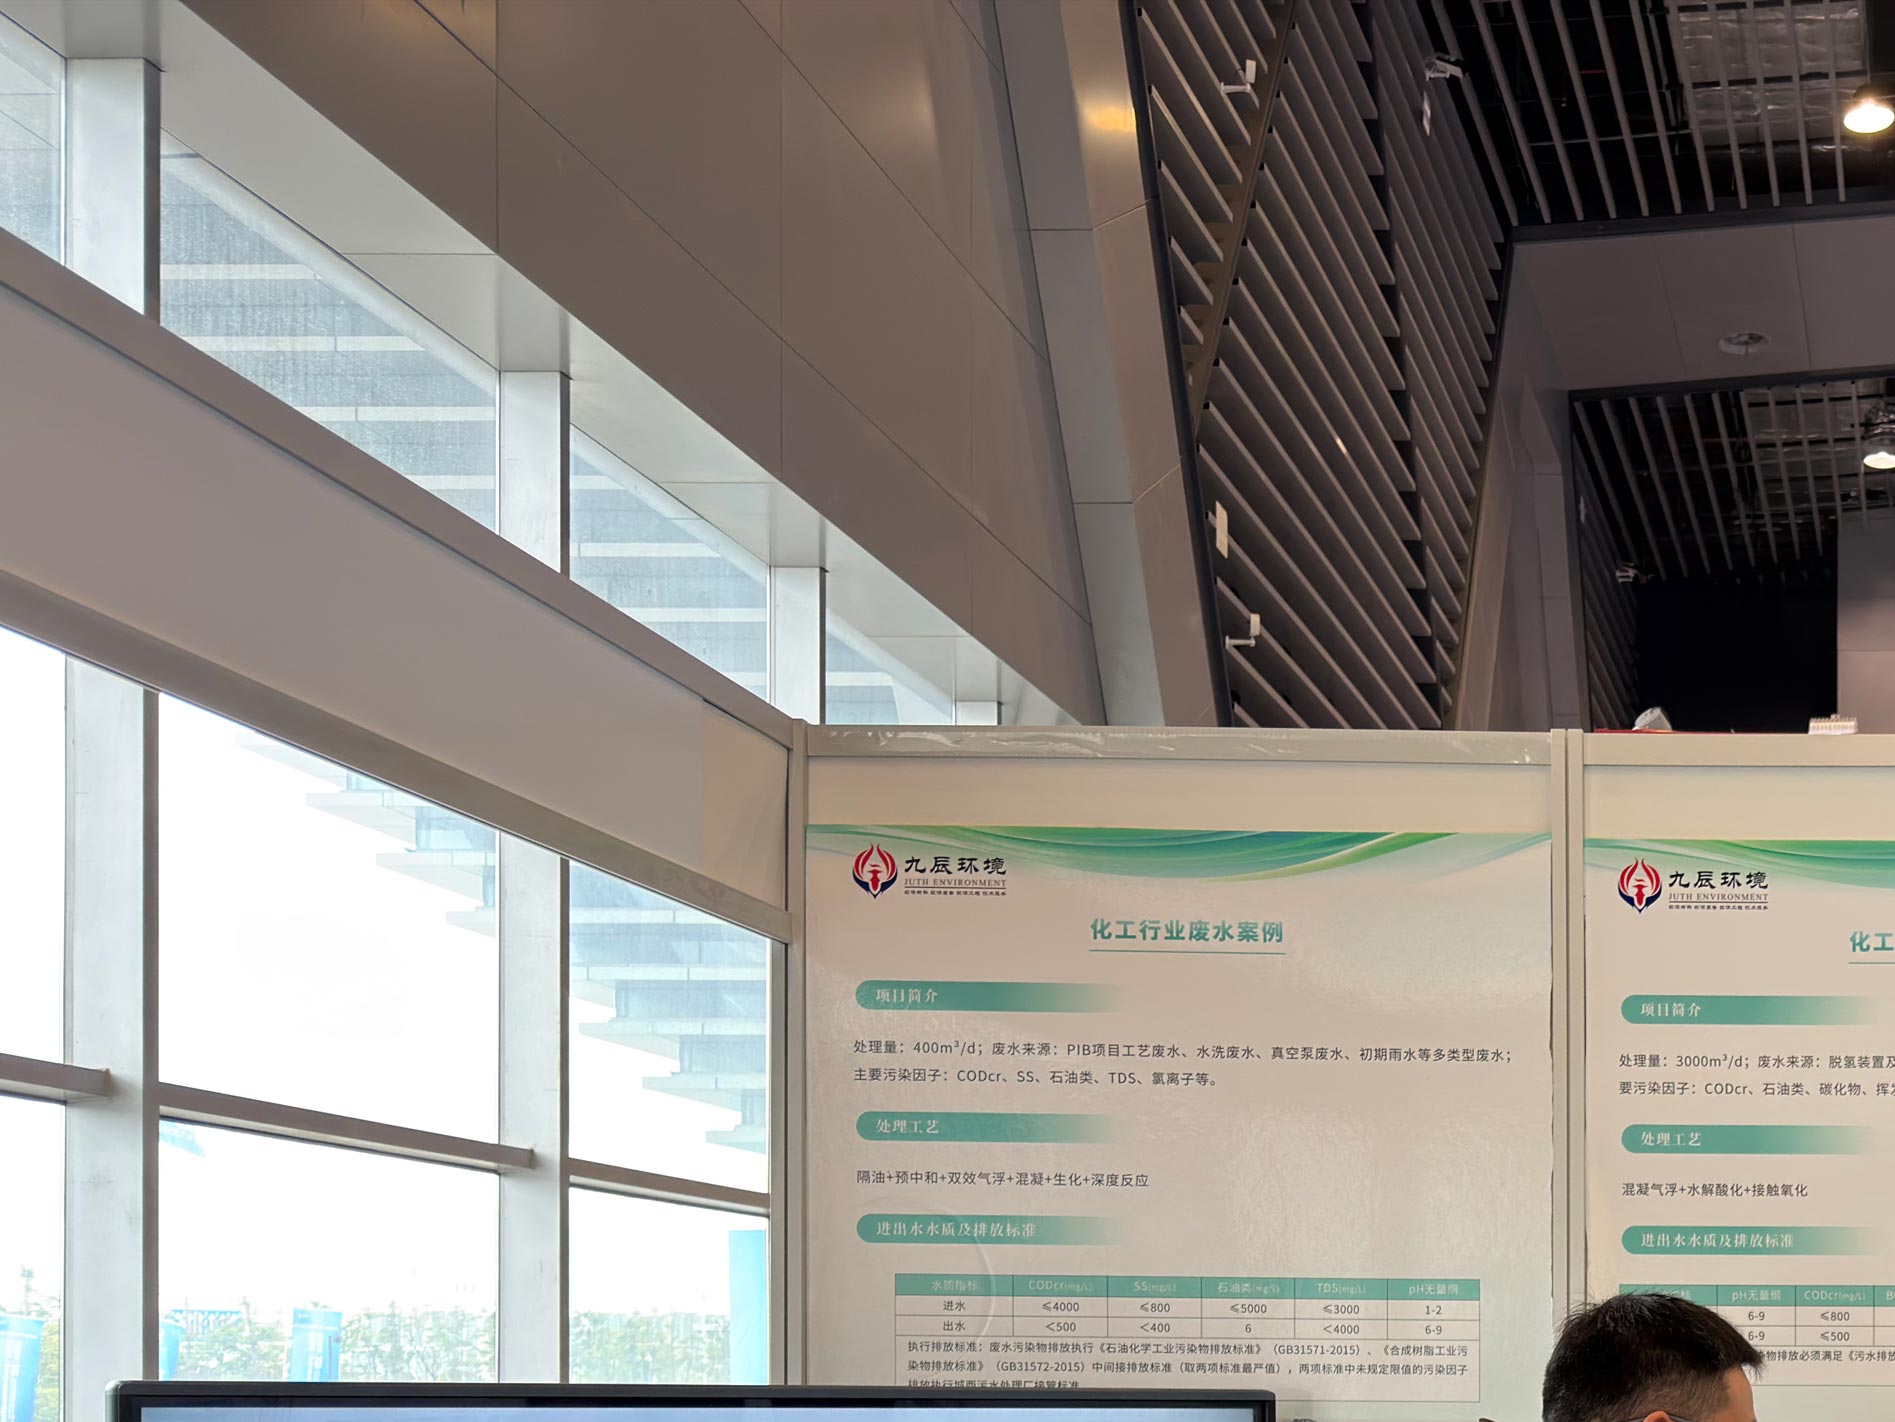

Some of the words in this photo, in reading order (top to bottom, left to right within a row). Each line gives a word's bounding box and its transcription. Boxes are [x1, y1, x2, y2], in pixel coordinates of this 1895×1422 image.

[904, 856, 1007, 875] 九辰环境
[933, 879, 1007, 887] ENVIRONMENT
[1668, 871, 1769, 889] 九辰环境
[1668, 893, 1693, 901] JUTH
[1696, 893, 1769, 901] ENVIRONMENT
[1090, 918, 1284, 943] 化工行业废水案例
[875, 987, 939, 1003] 项目简介
[1640, 1002, 1702, 1017] 项目简介
[876, 1118, 940, 1134] 处理工艺
[1640, 1131, 1702, 1147] 处理工艺
[856, 1170, 1149, 1187] 隔油+预中和+双效气浮+混凝+生化+深度反应
[1621, 1182, 1809, 1198] 混凝气浮+水解酸化+接触氧化
[876, 1221, 1037, 1238] 进出水水质及排放标准
[1640, 1232, 1795, 1249] 进出水水质及排放标准
[942, 1300, 966, 1312] 进水
[1041, 1301, 1080, 1313] ≤4000
[1139, 1302, 1171, 1313] ≤800
[1229, 1303, 1268, 1314] ≤5000
[1322, 1304, 1360, 1315] ≤3000
[1425, 1305, 1443, 1316] 1-2
[1747, 1311, 1766, 1321] 6-9
[1820, 1311, 1851, 1322] ≤800
[942, 1320, 966, 1332] 出水
[1045, 1322, 1077, 1333] <500
[1139, 1322, 1171, 1333] <400
[1244, 1323, 1252, 1334] 6
[1322, 1324, 1360, 1335] <4000
[1425, 1325, 1443, 1336] 6-9
[1747, 1331, 1766, 1341] 6-9
[1820, 1331, 1851, 1342] ≤500
